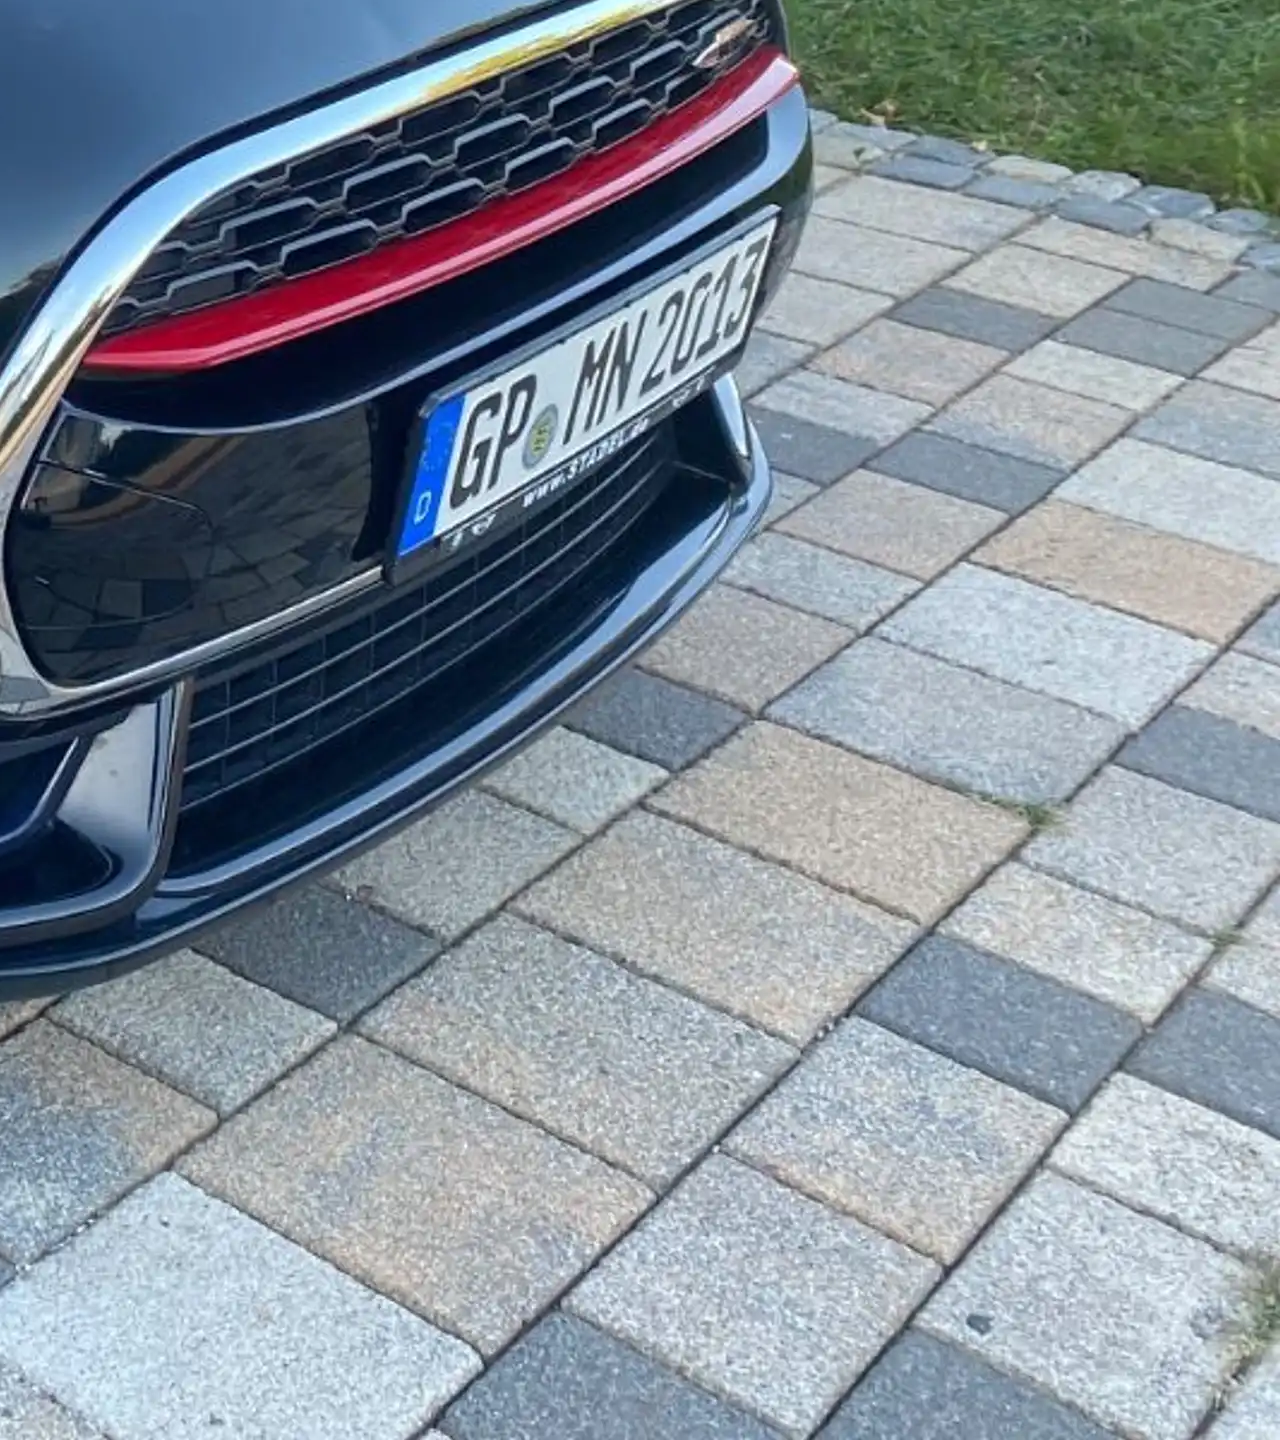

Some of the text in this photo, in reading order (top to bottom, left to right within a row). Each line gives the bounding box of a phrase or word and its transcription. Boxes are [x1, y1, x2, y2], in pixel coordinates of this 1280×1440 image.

[449, 235, 770, 511] GP MN 2013
[413, 490, 433, 526] D
